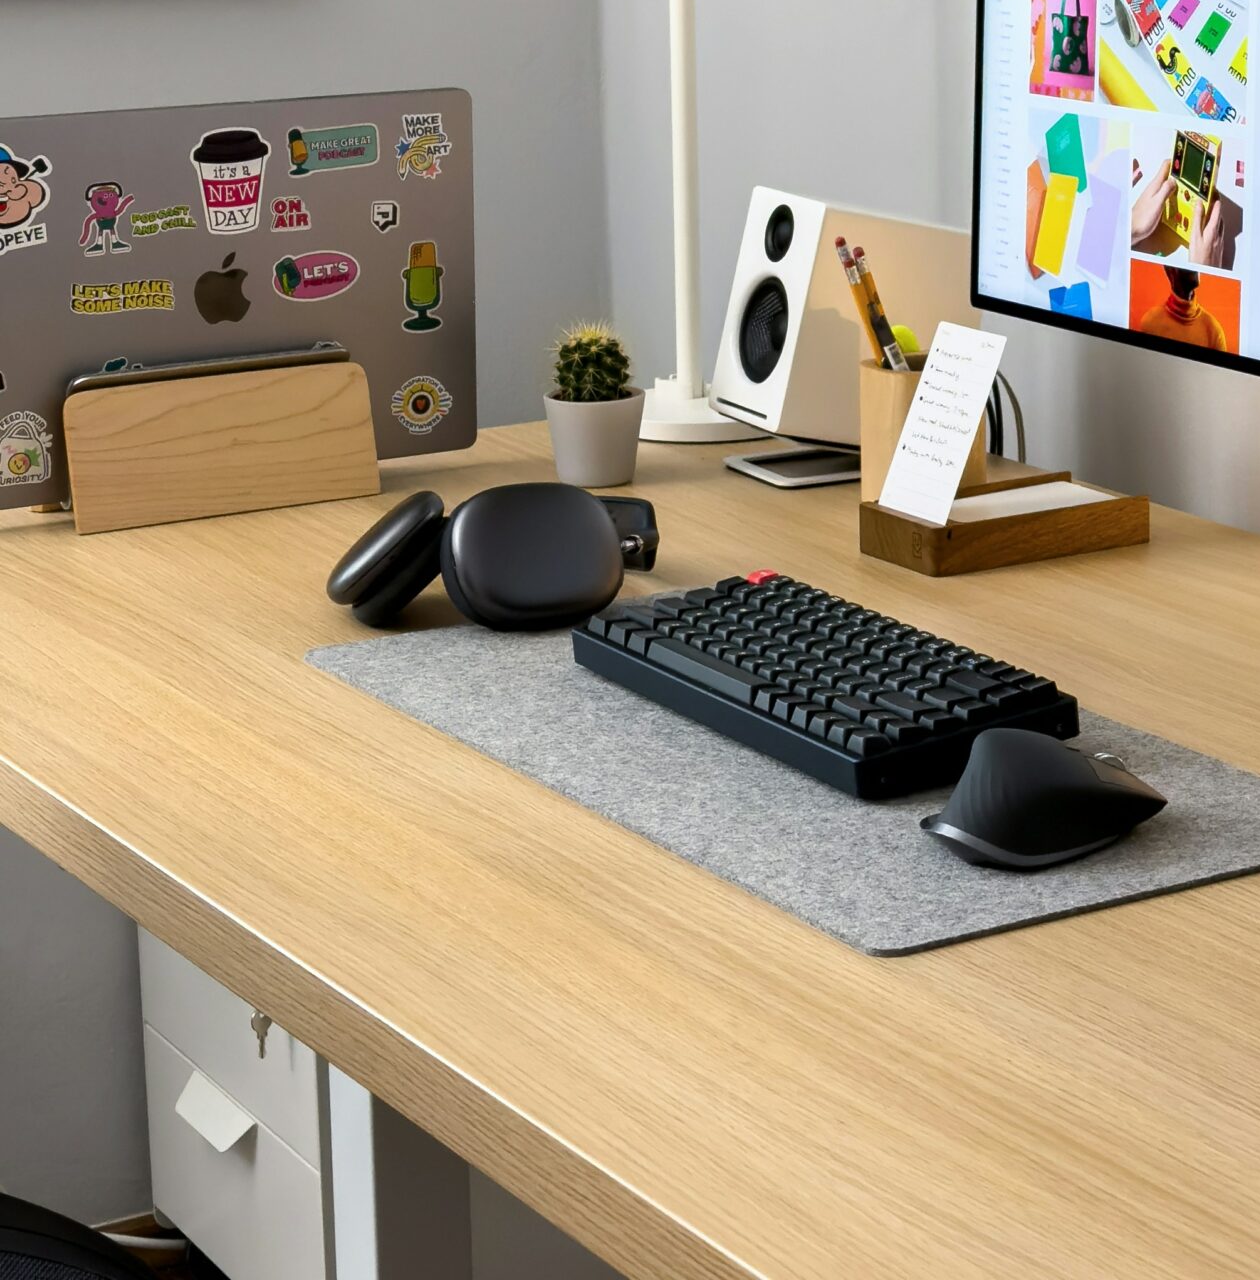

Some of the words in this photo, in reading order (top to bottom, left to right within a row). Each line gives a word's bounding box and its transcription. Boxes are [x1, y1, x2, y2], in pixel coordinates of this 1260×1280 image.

[405, 115, 440, 128] MAKE
[407, 125, 440, 139] MORE
[311, 138, 338, 151] MAKE
[340, 135, 372, 148] GREAT
[426, 144, 450, 156] ART
[213, 165, 237, 179] it's
[242, 165, 251, 177] a
[207, 180, 258, 203] NEW
[130, 205, 191, 224] PODCAST
[273, 199, 302, 214] ON
[213, 207, 254, 227] DAY
[273, 213, 309, 229] AIR
[132, 222, 160, 237] AND
[161, 217, 197, 232] CHILL
[304, 261, 349, 280] LET'S
[72, 284, 121, 299] LET'S
[122, 279, 173, 296] MAKE
[72, 298, 121, 314] SOME
[122, 294, 174, 310] NOISE
[24, 412, 46, 430] YOUR
[0, 472, 42, 487] URIOSITY
